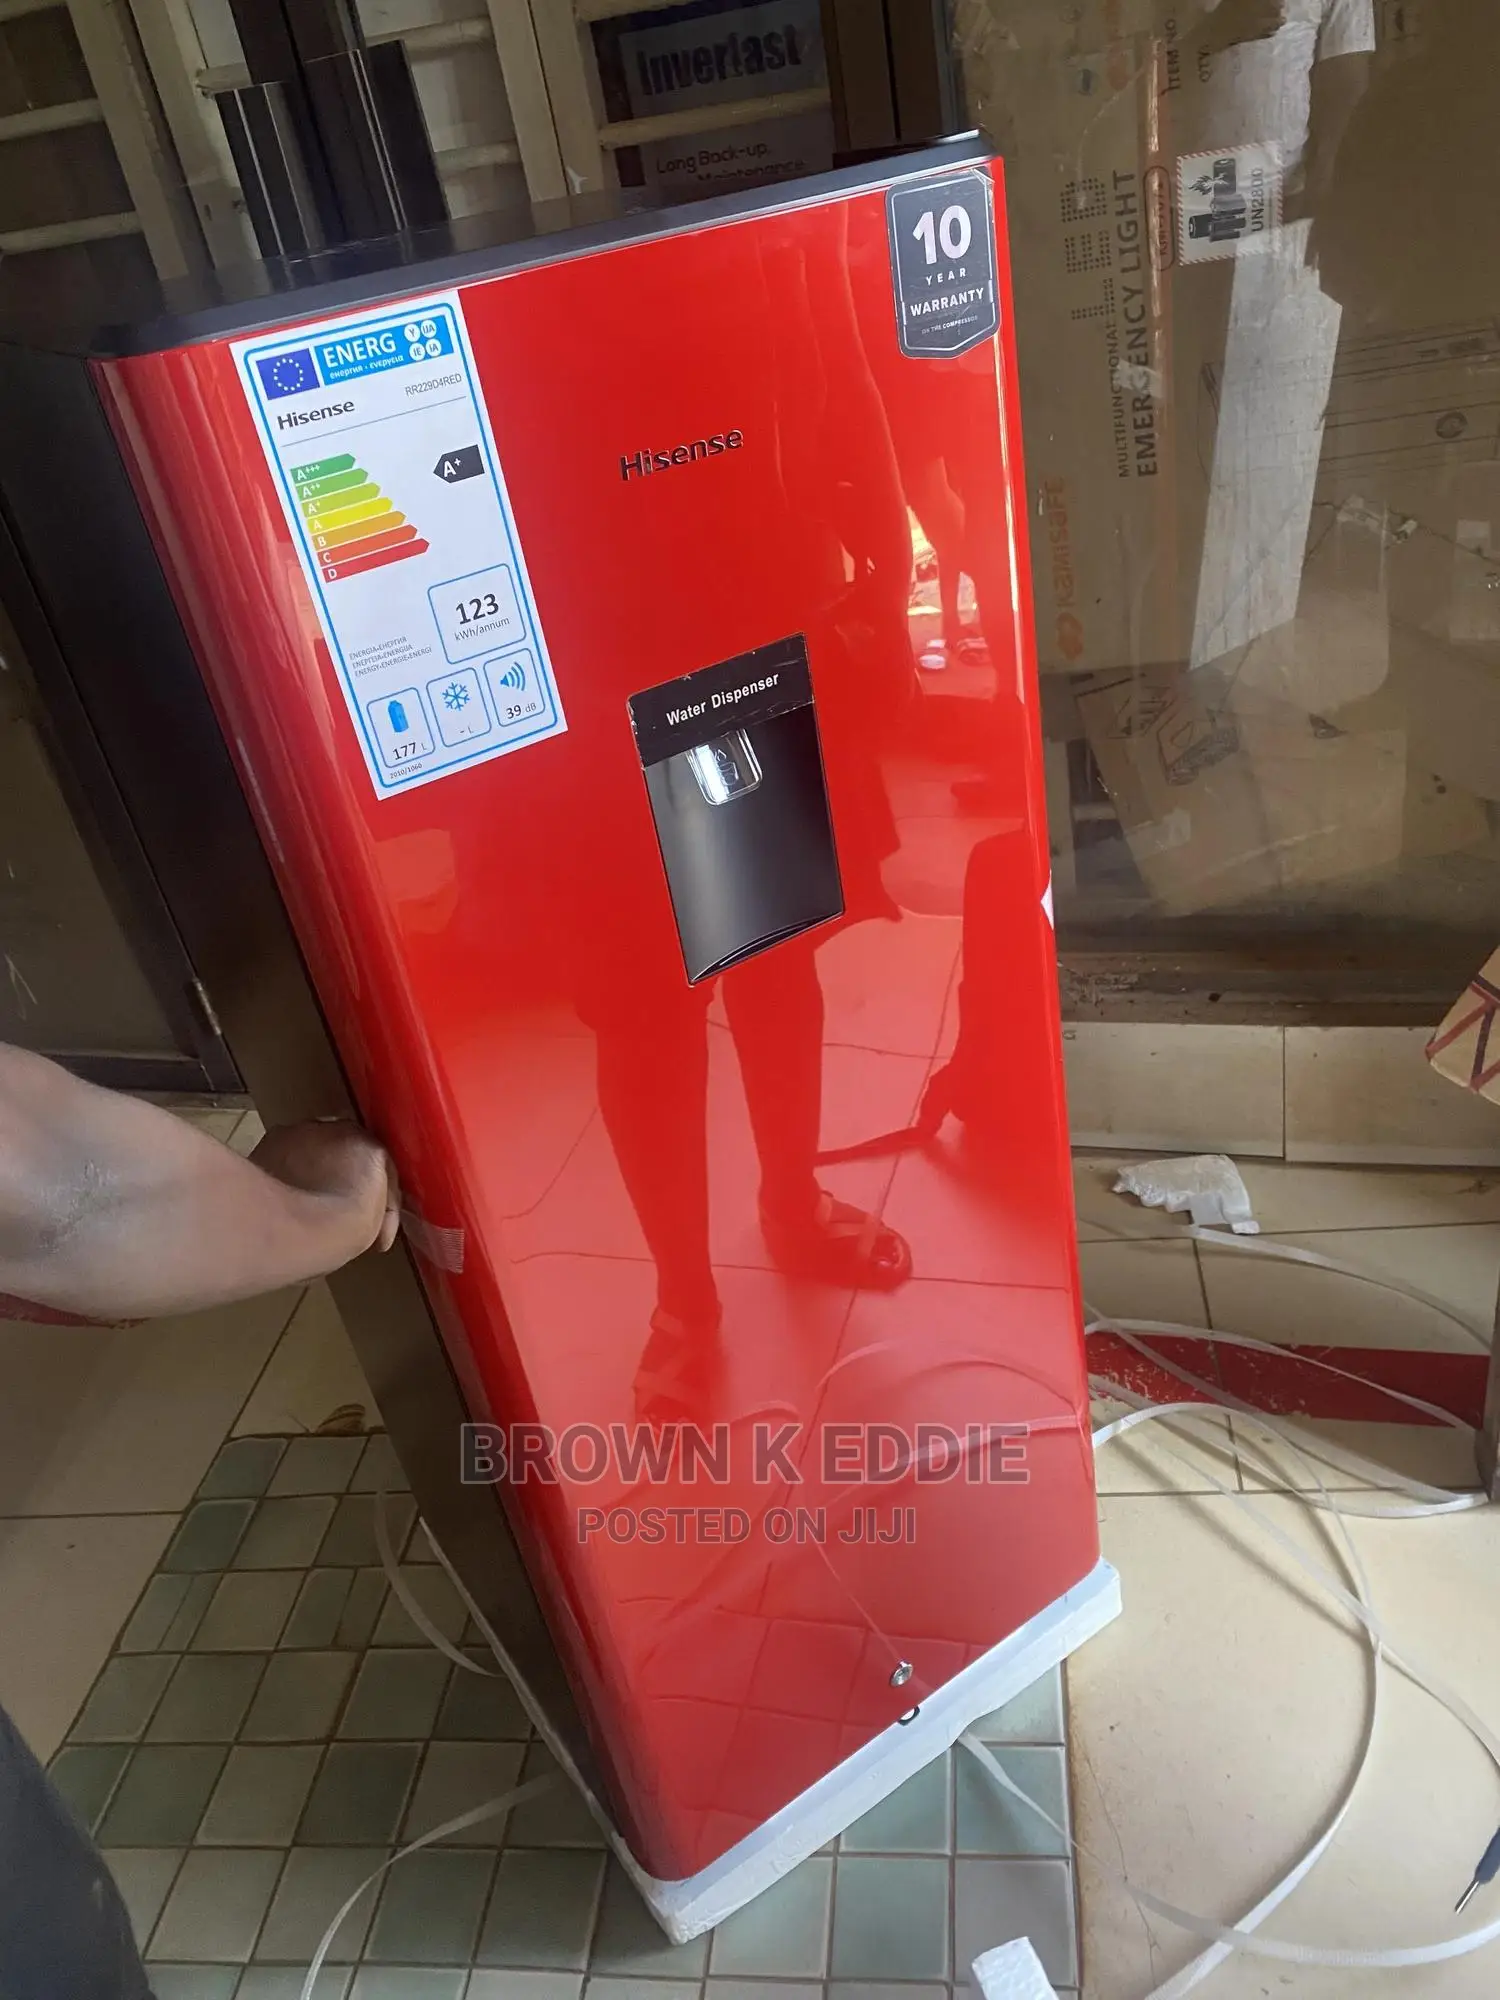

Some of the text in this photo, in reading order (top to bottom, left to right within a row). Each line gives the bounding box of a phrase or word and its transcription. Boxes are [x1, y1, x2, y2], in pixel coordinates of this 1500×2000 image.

[656, 156, 697, 174] Long
[912, 205, 972, 265] 10
[1060, 178, 1117, 320] LED
[925, 267, 967, 286] YEAR
[910, 288, 984, 317] WARRANTY
[1112, 170, 1158, 478] EMERGENCY LIGHT
[323, 332, 397, 369] ENERG
[405, 373, 462, 396] RR229D4RED
[277, 400, 356, 430] Hisense
[619, 428, 745, 481] Hisense
[443, 457, 462, 478] A+
[313, 519, 323, 530] A
[317, 535, 327, 547] B
[322, 552, 331, 563] C
[328, 568, 338, 579] D
[455, 593, 500, 625] 123
[454, 616, 511, 641] kWh/annum
[505, 702, 538, 720] 39 dB
[666, 673, 780, 726] Water Dispenser
[393, 742, 417, 760] 177
